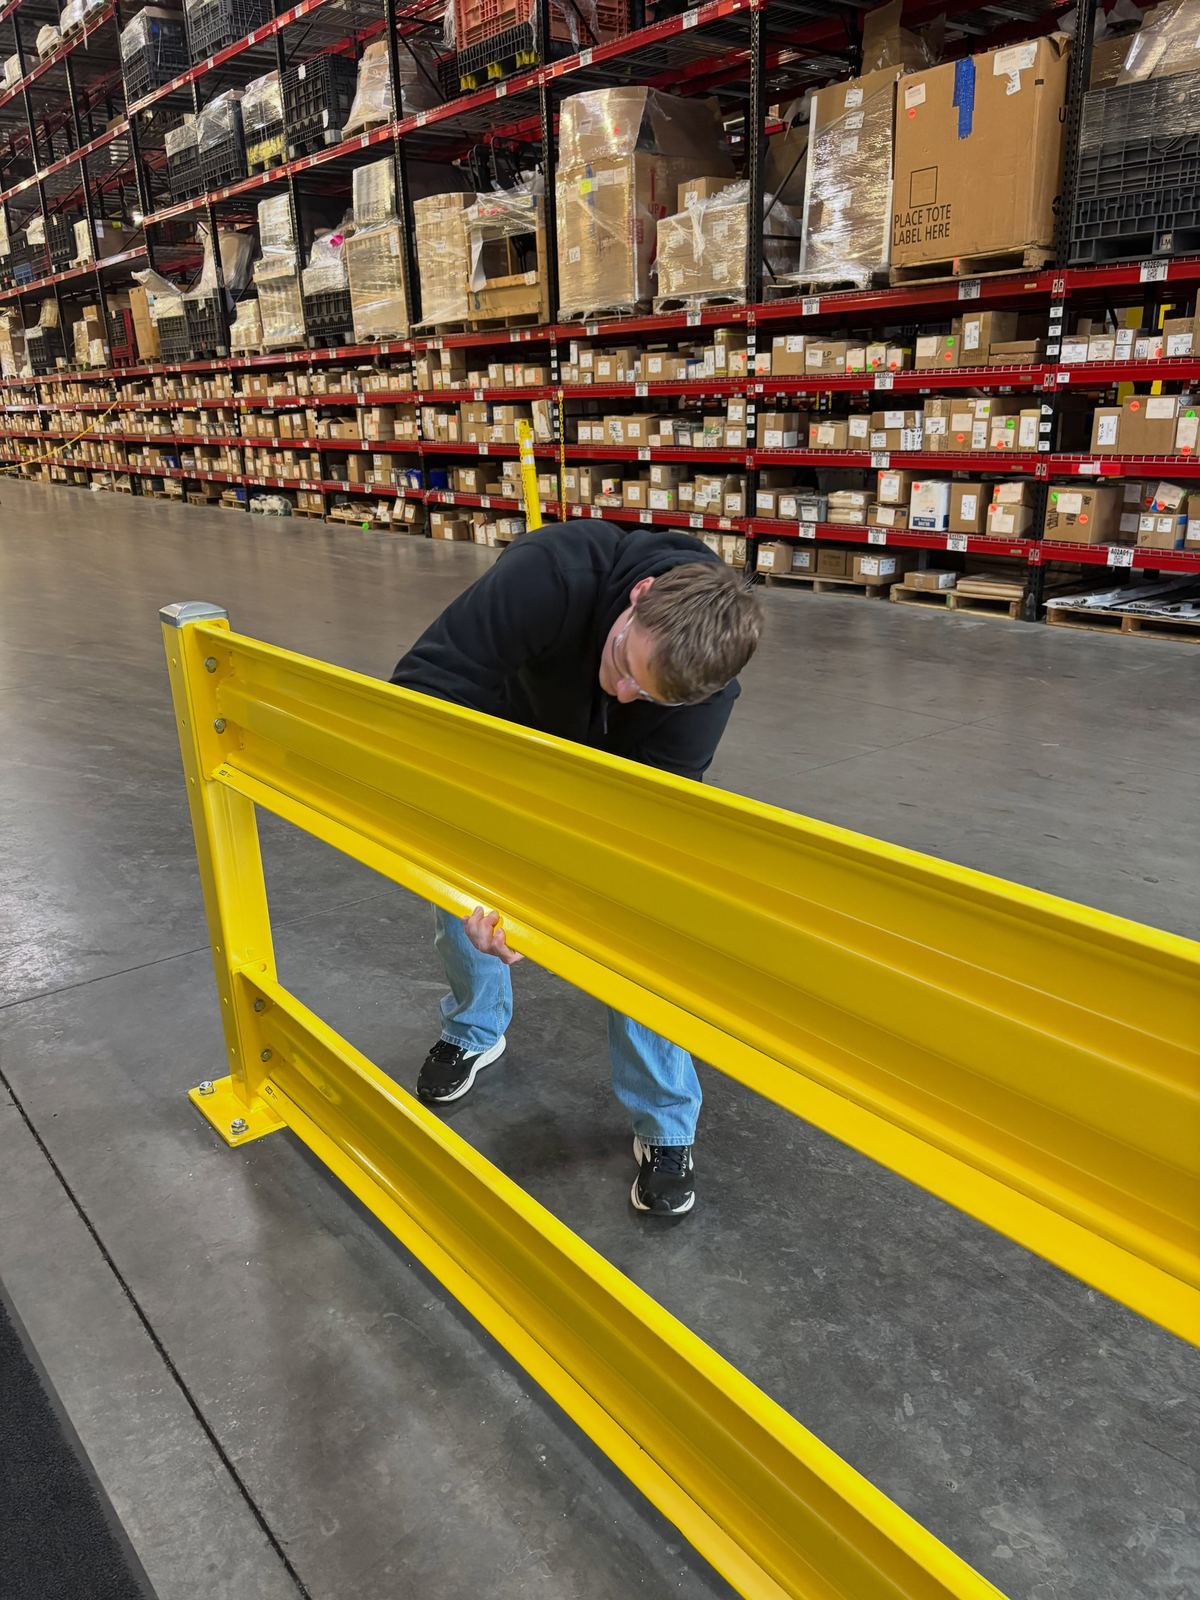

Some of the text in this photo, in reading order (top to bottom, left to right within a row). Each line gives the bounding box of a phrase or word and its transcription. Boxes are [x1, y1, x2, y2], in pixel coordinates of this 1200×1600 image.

[894, 204, 951, 229] PLACE TOTE
[893, 222, 950, 246] LABEL HERE
